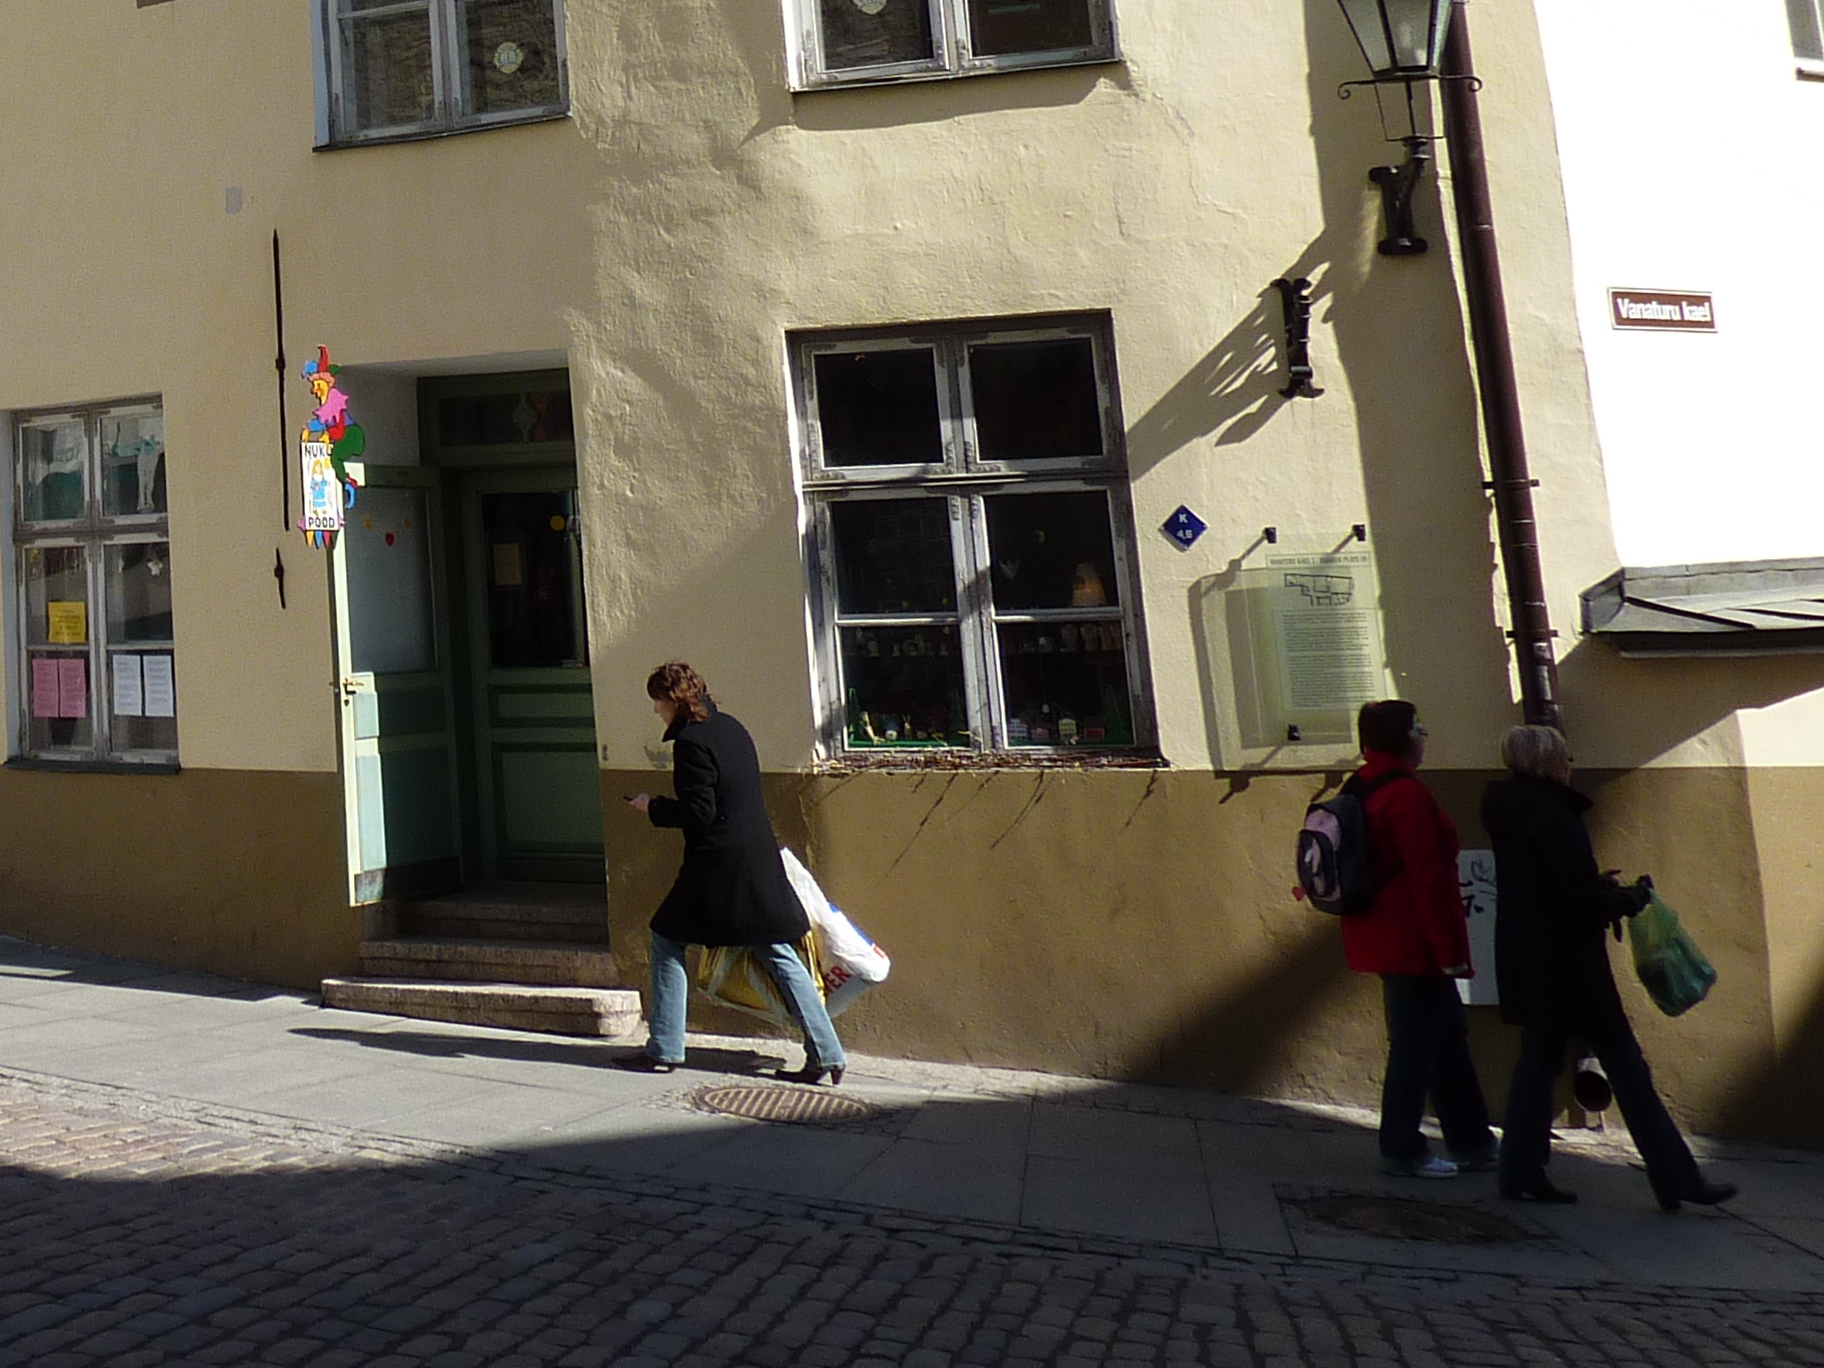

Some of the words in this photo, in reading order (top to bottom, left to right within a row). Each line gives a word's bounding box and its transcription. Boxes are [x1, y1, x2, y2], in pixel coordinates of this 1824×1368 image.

[1616, 297, 1682, 321] Vanaturu
[1681, 300, 1712, 322] kael
[308, 516, 336, 529] POOD
[1178, 513, 1188, 523] K
